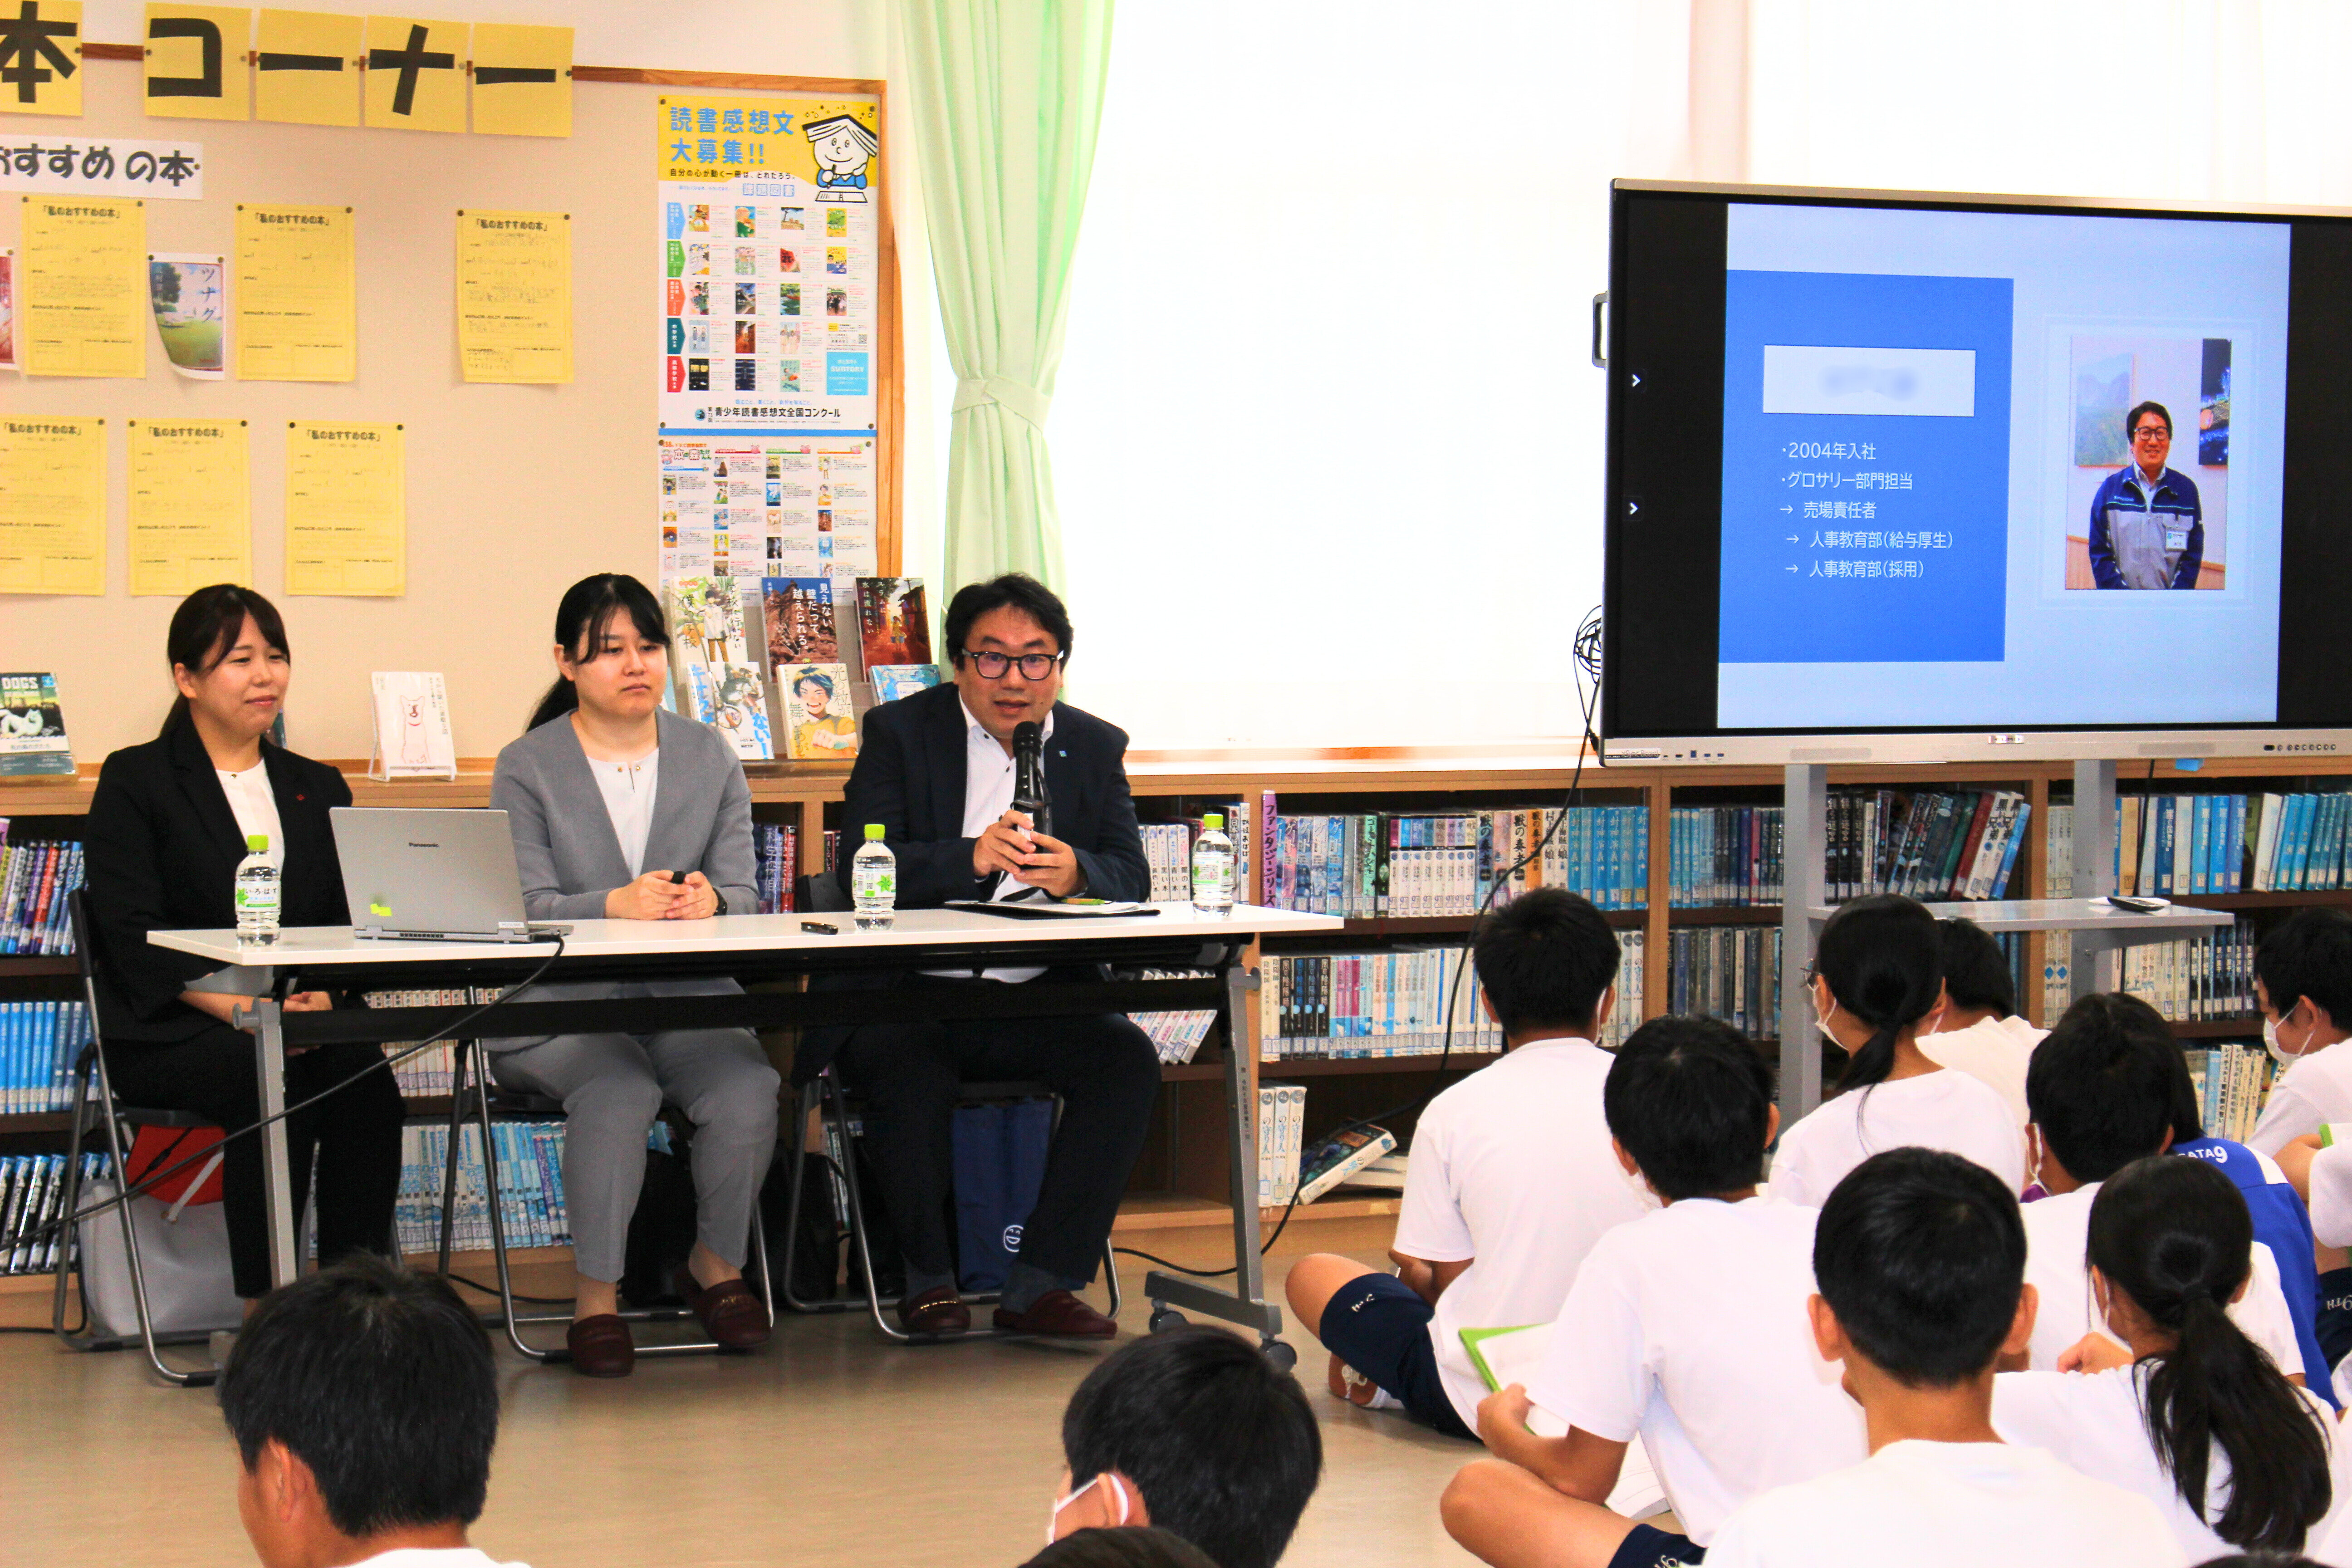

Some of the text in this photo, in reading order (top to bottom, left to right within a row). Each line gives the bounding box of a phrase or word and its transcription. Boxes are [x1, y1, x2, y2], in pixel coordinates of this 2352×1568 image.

[0, 0, 557, 116] 本 コーナー
[670, 106, 794, 135] 読書感想文
[670, 137, 764, 164] 大募集!!
[202, 268, 218, 323] ツナグ
[715, 407, 841, 418] 青少年読書感想文全国コンクール
[1803, 501, 1877, 519] 売場責任者
[1809, 560, 1924, 578] 人事教育部（採用）
[819, 583, 833, 627] 見えない
